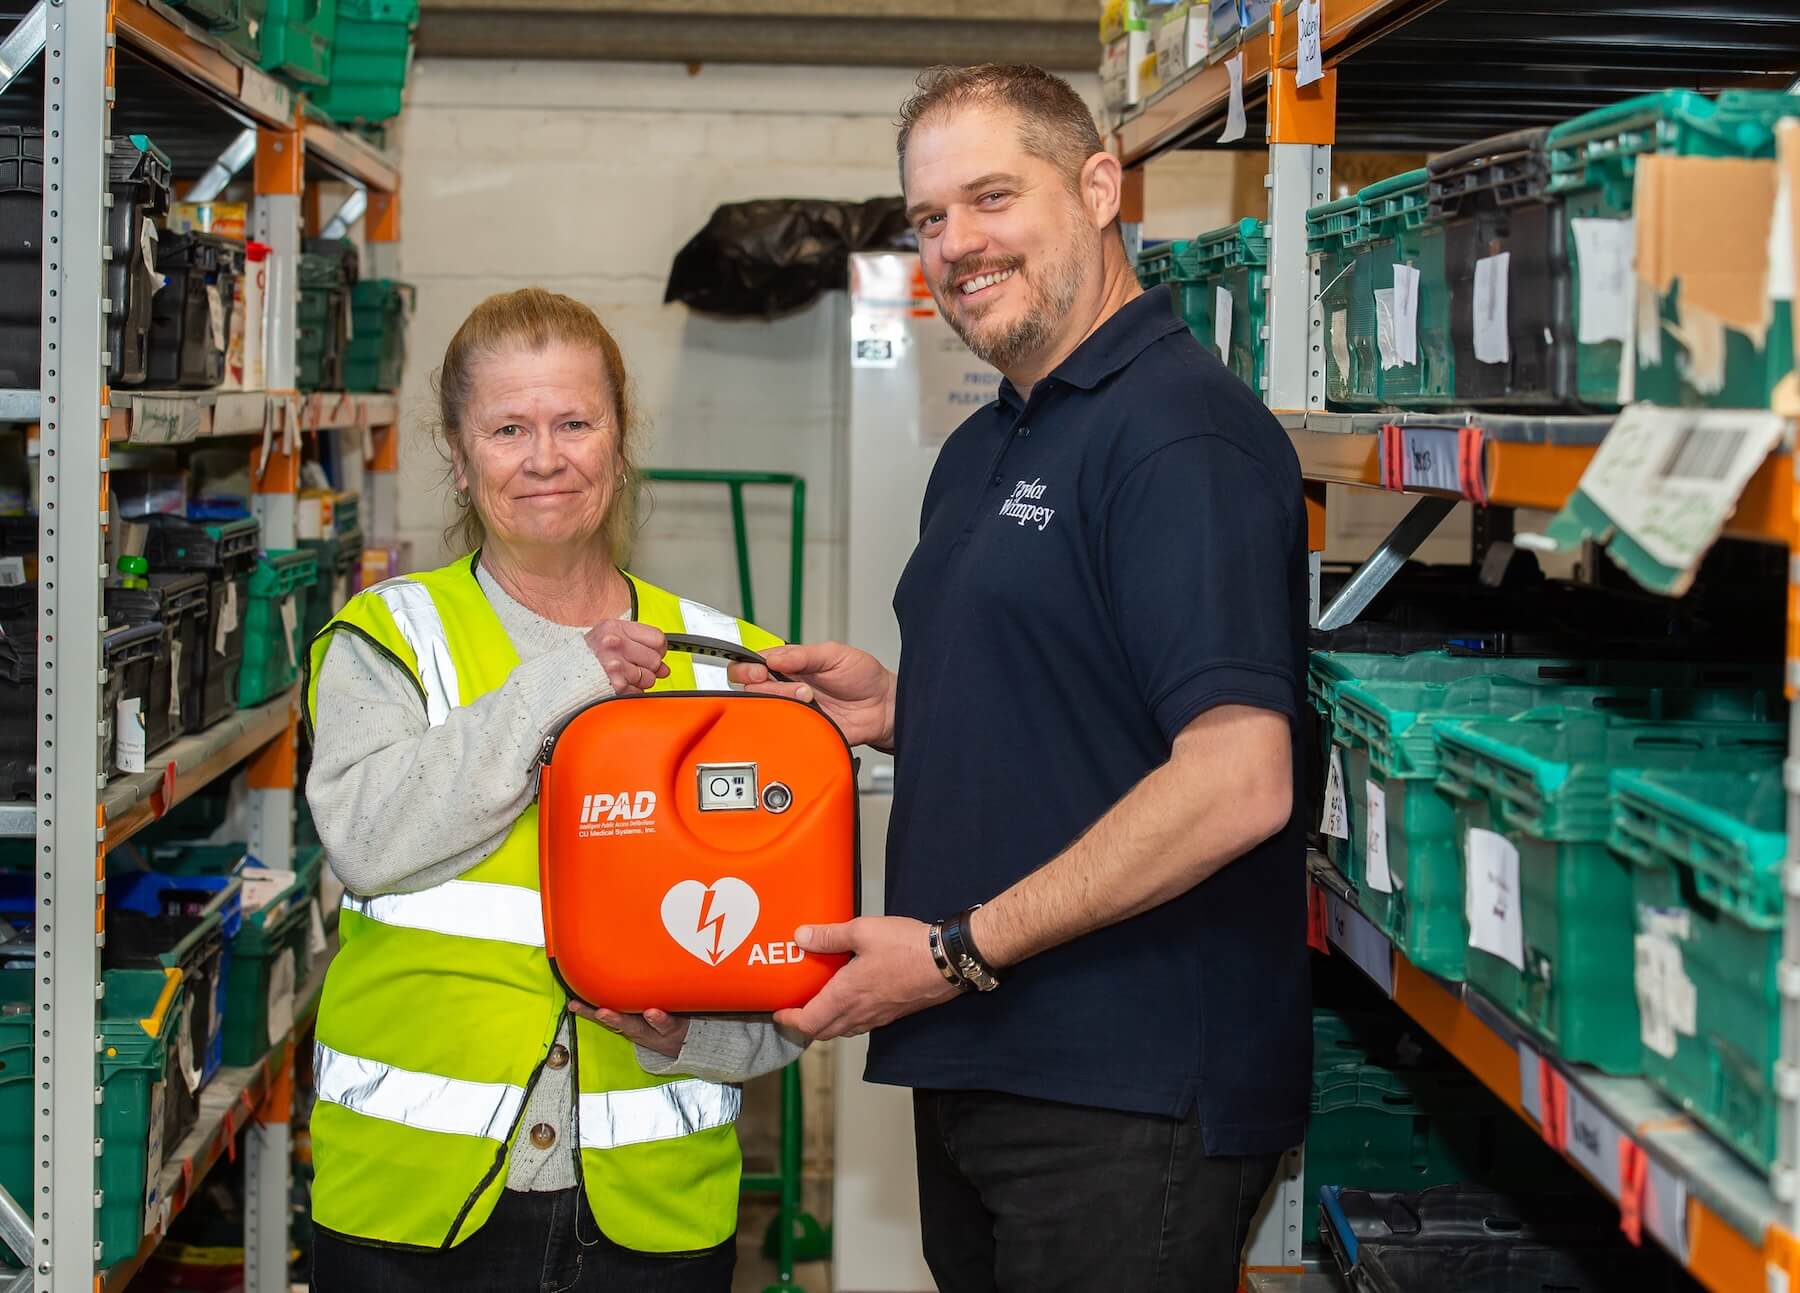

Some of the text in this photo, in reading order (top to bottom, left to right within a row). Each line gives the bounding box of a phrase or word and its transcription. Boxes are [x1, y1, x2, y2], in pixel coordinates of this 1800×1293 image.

[1010, 477, 1047, 504] Taylor
[999, 498, 1056, 531] Wimpey
[580, 791, 657, 823] IPAD
[590, 829, 614, 837] Medical
[747, 941, 805, 966] AED
